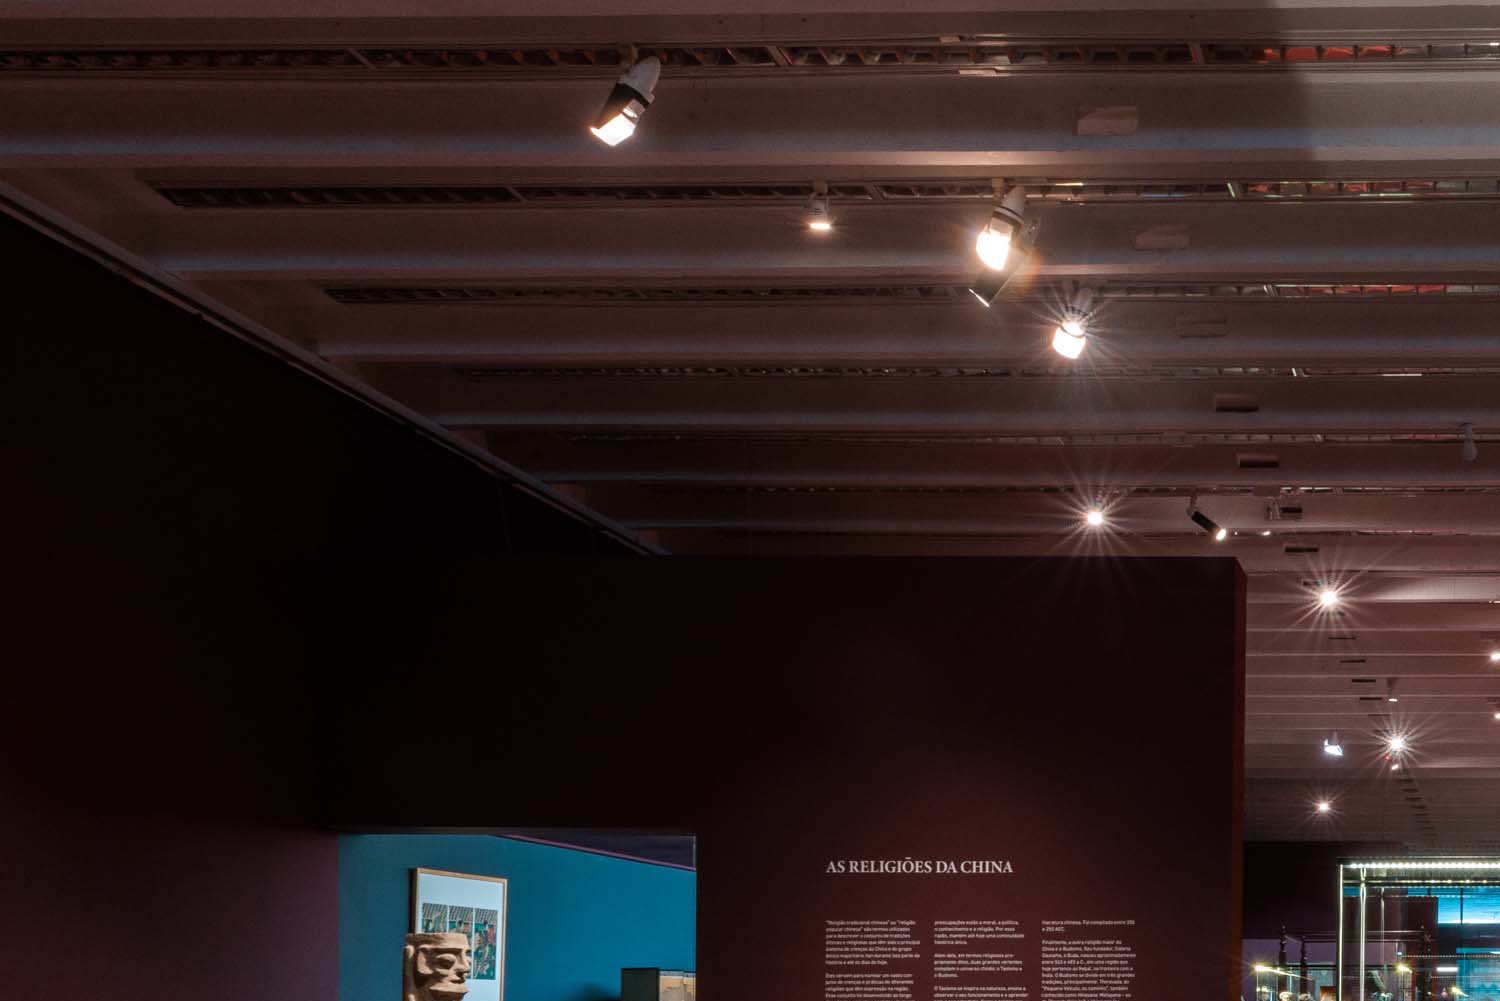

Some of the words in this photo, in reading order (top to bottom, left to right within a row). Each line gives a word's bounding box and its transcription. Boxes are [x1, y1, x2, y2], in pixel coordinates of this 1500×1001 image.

[826, 861, 846, 873] AS
[849, 856, 933, 874] RELIGIÕES
[935, 861, 958, 874] DA
[960, 861, 1014, 874] CHINA
